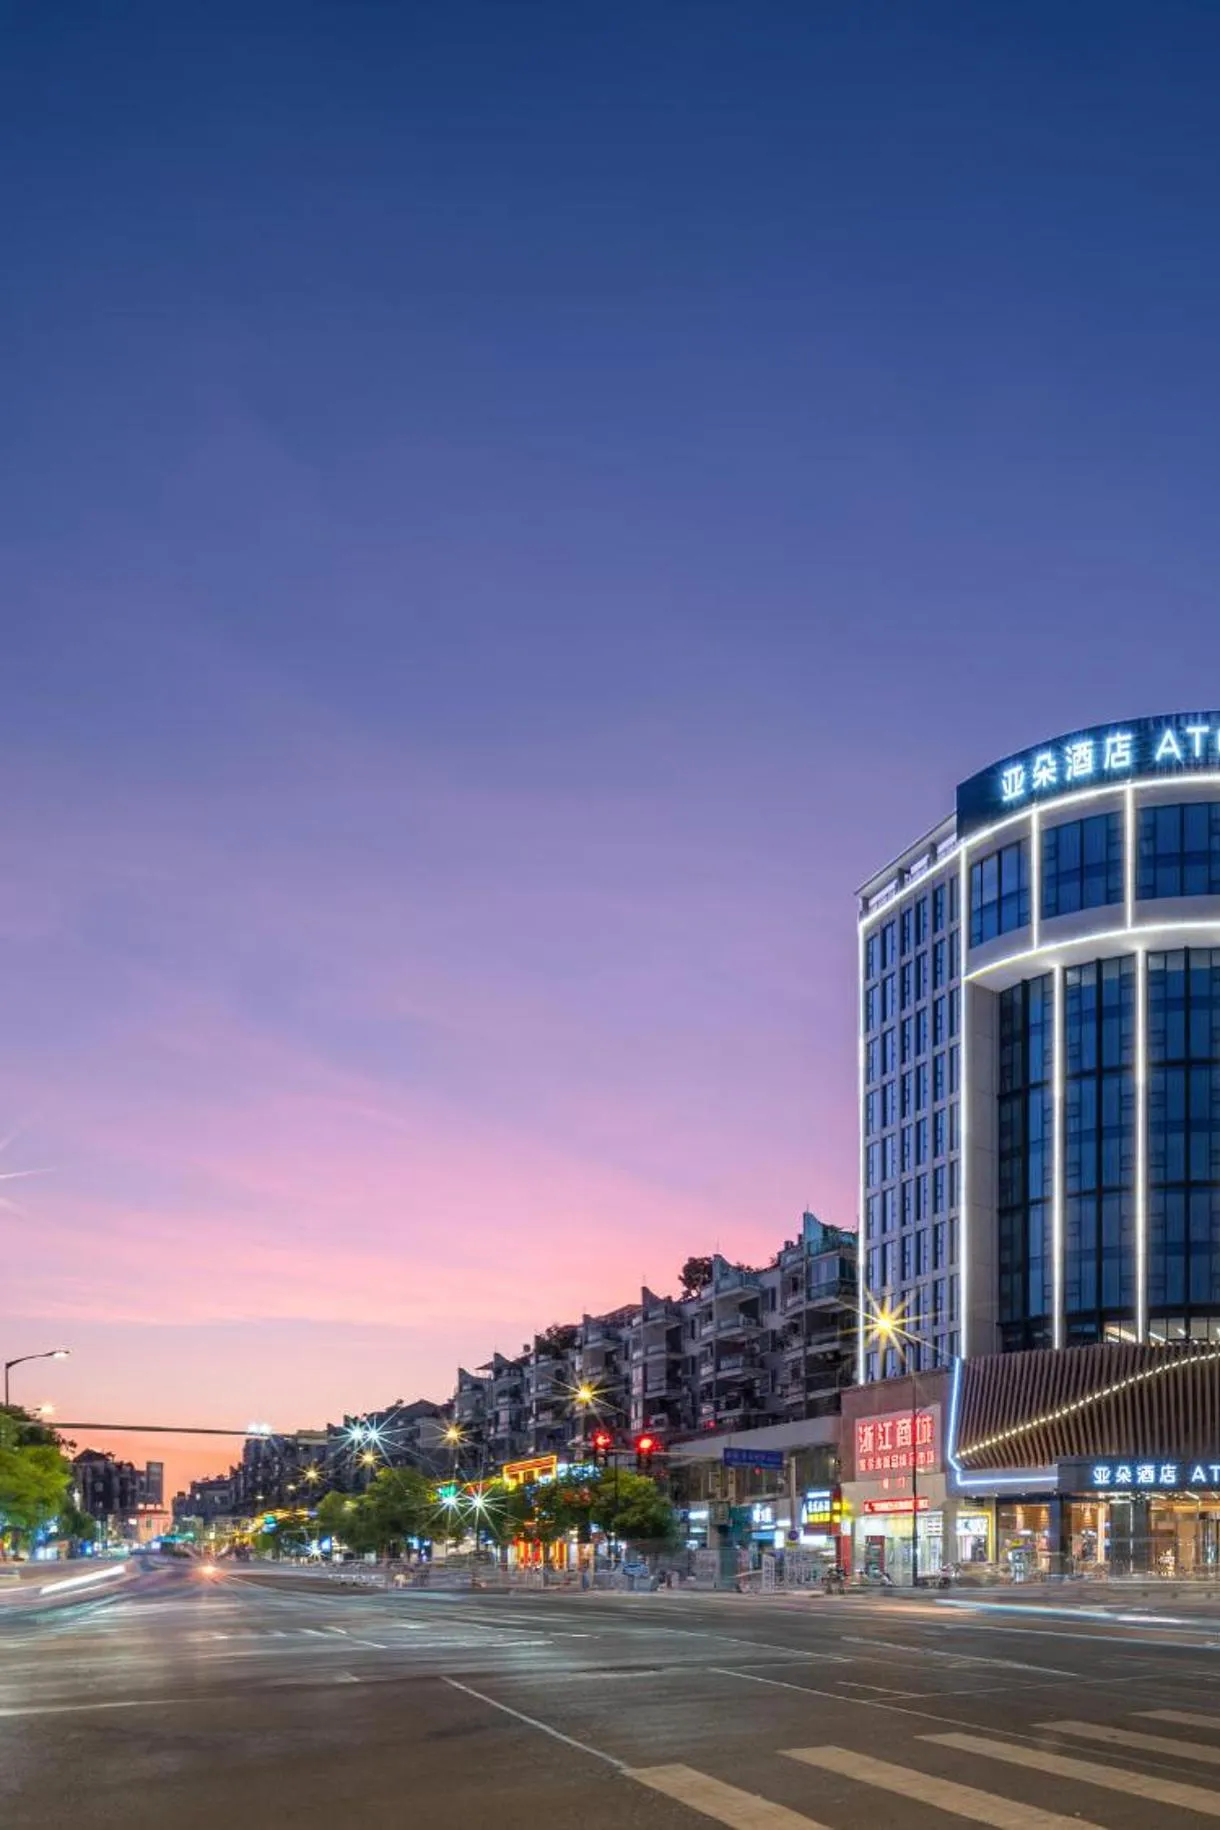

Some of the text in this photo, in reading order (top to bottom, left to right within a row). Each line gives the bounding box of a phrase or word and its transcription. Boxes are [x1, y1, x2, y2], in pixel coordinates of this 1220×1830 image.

[1002, 732, 1133, 801] 亚朵酒店
[1093, 1464, 1177, 1485] 亚朵酒店
